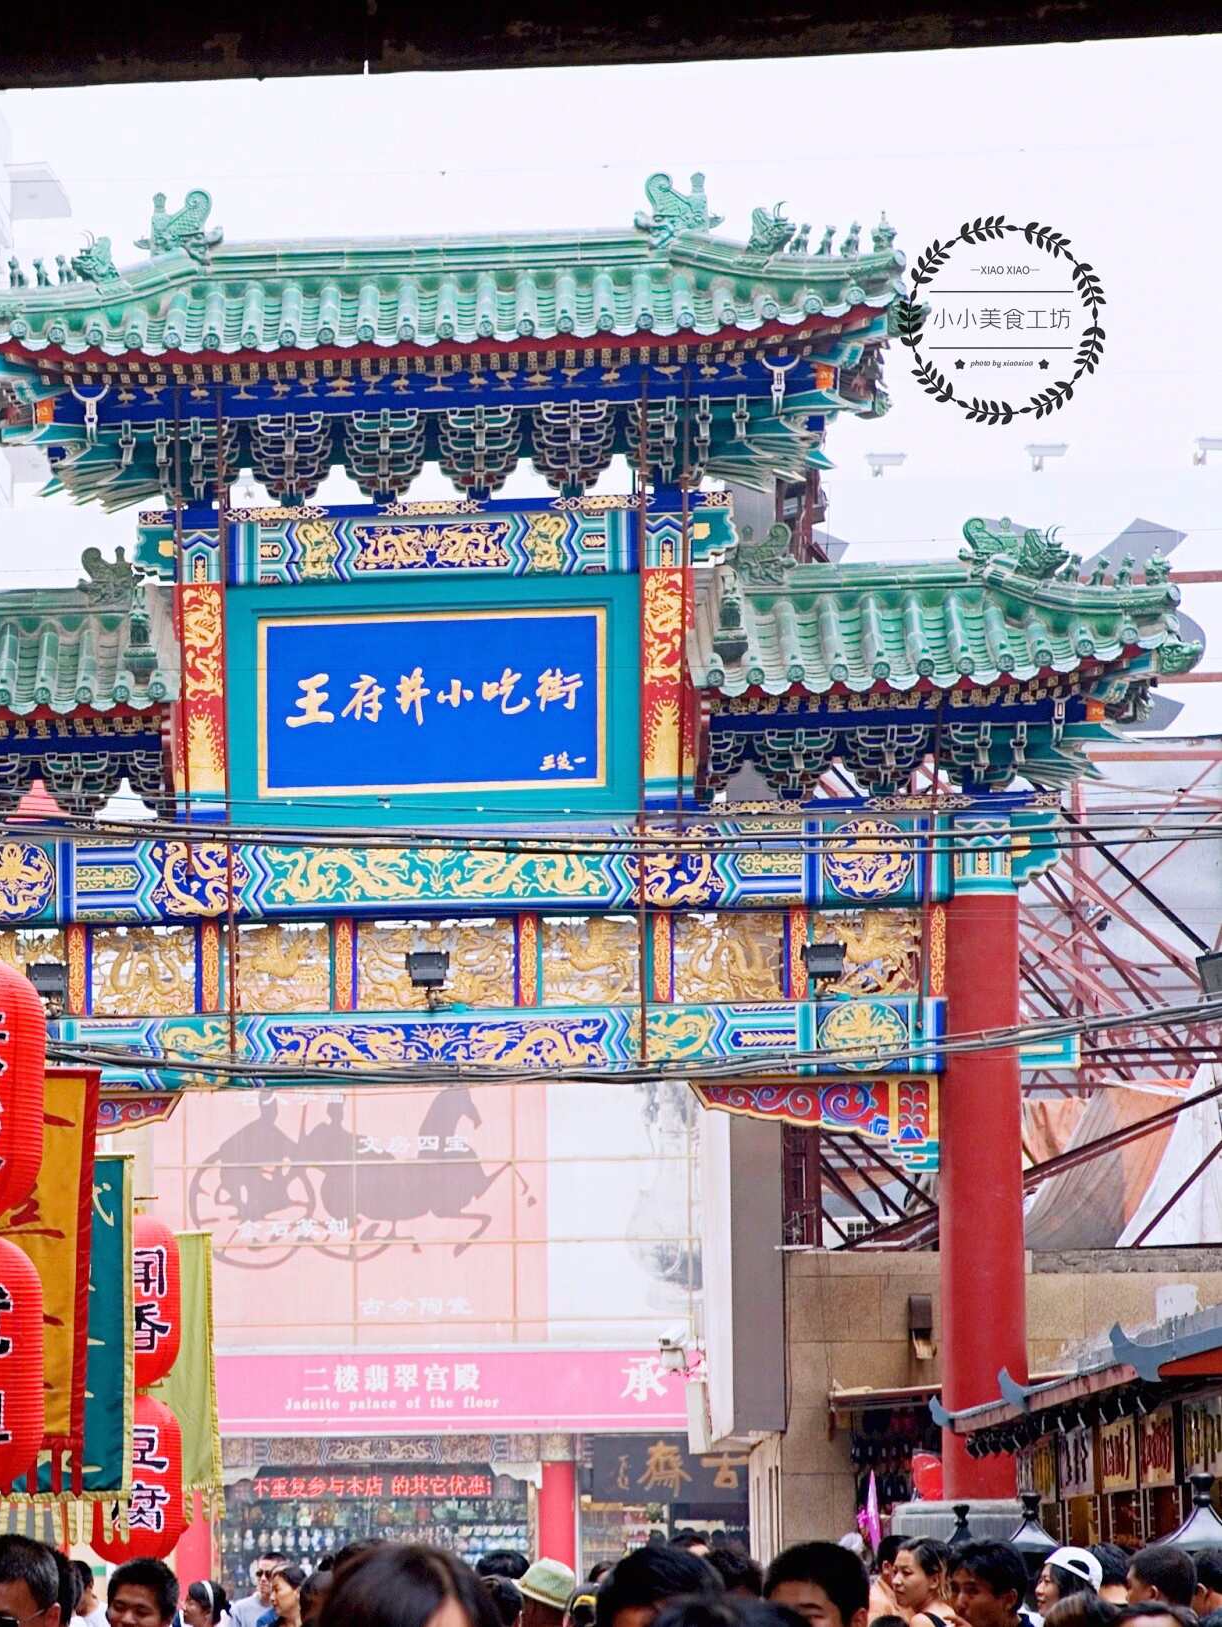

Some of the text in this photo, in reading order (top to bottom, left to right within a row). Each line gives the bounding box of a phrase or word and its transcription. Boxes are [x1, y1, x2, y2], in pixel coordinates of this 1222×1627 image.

[285, 666, 584, 728] 王府井小吃街
[302, 1363, 480, 1393] 二楼翡翠宫殿
[620, 1357, 668, 1403] 承
[285, 1396, 500, 1412] Jadeite palace of the floor
